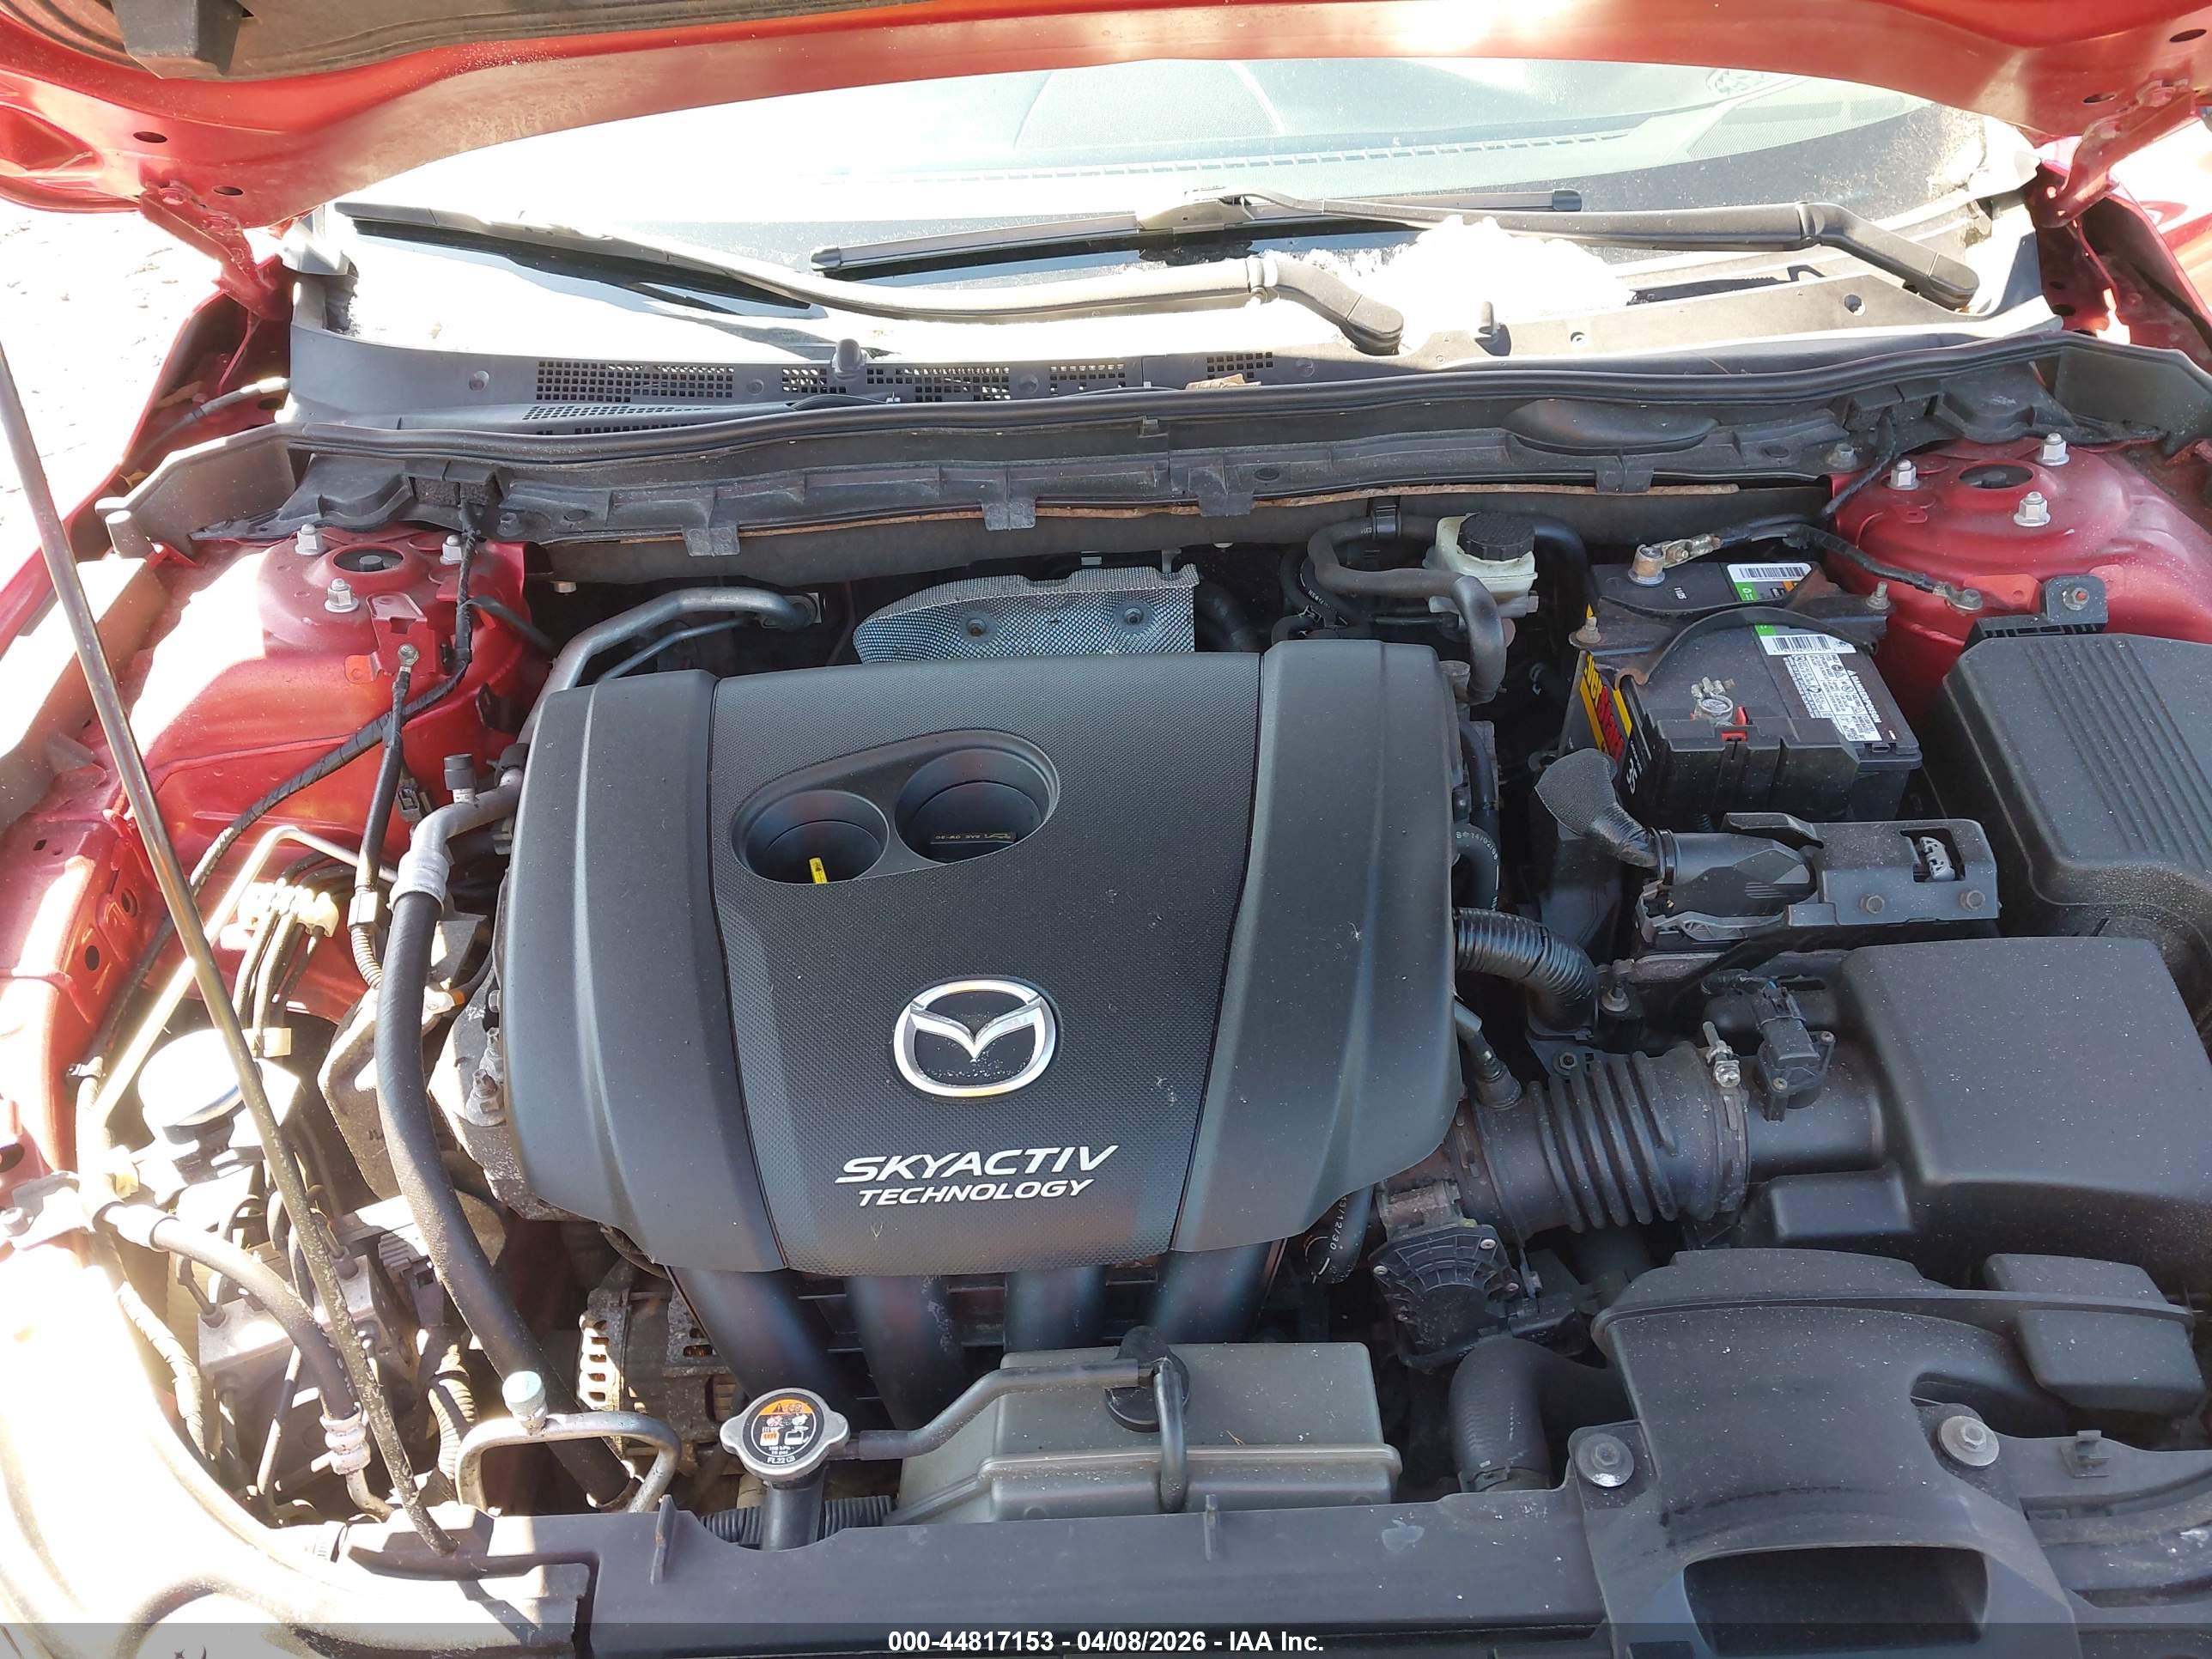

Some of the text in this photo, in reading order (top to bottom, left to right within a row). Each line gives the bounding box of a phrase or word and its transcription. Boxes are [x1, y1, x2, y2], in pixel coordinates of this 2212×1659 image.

[1626, 759, 1638, 795] 35
[835, 1145, 1120, 1183] SKYACTIV
[859, 1179, 1095, 1206] TECHNOLOGY
